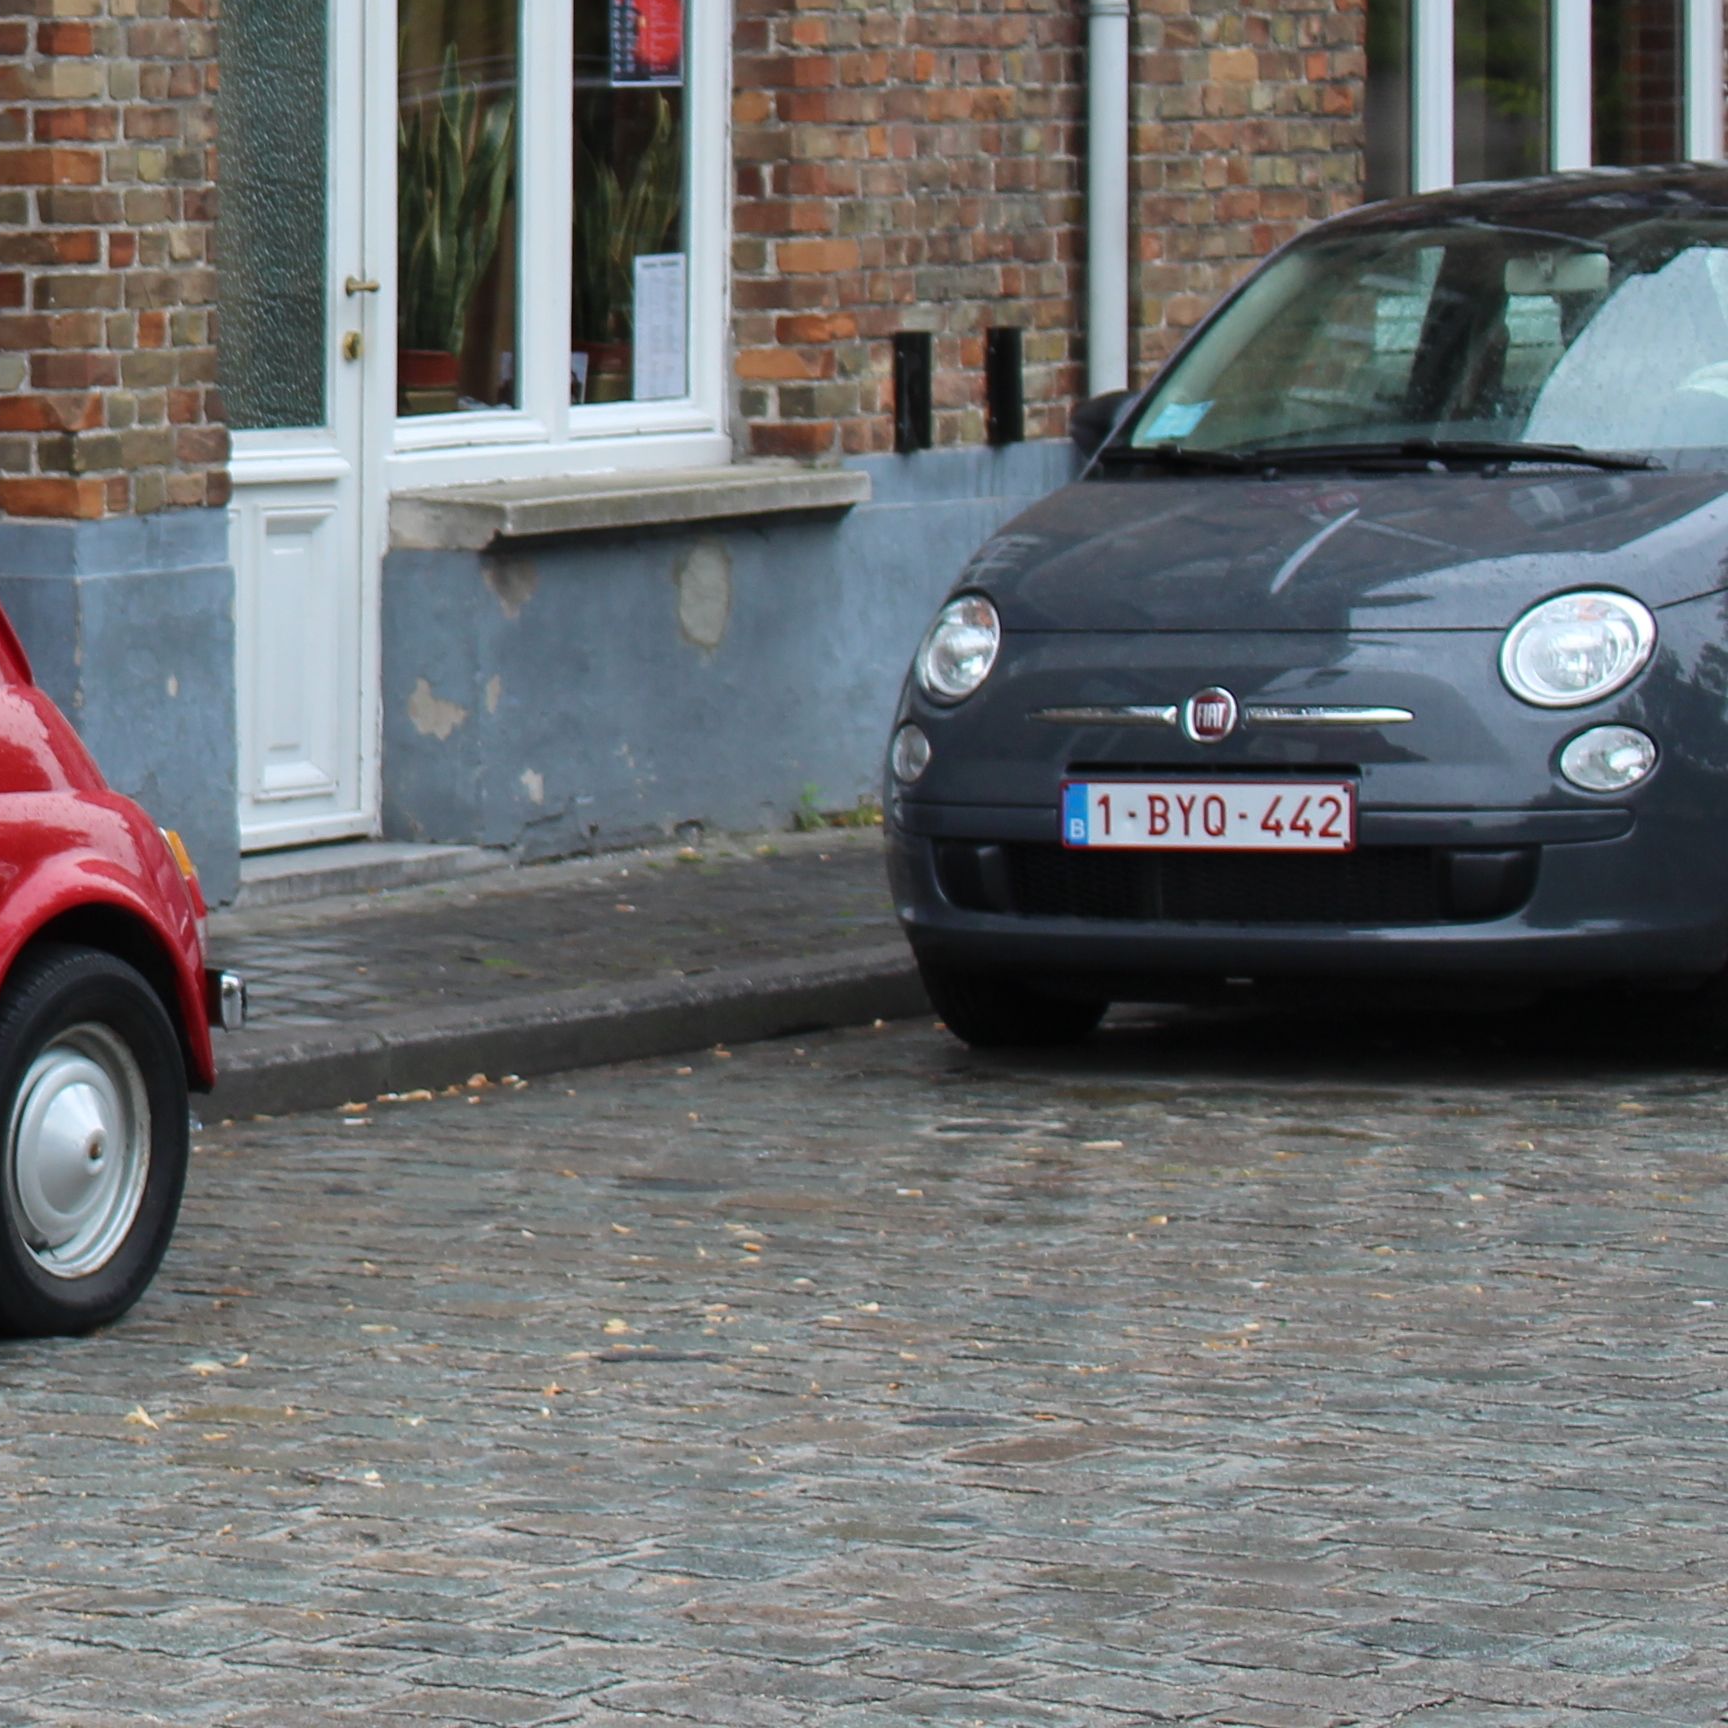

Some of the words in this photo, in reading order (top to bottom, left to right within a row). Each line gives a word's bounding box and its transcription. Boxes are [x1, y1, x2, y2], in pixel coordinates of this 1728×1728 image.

[1196, 703, 1226, 728] FIAT
[1070, 818, 1085, 839] B
[1096, 793, 1343, 839] 1-BYQ-442
